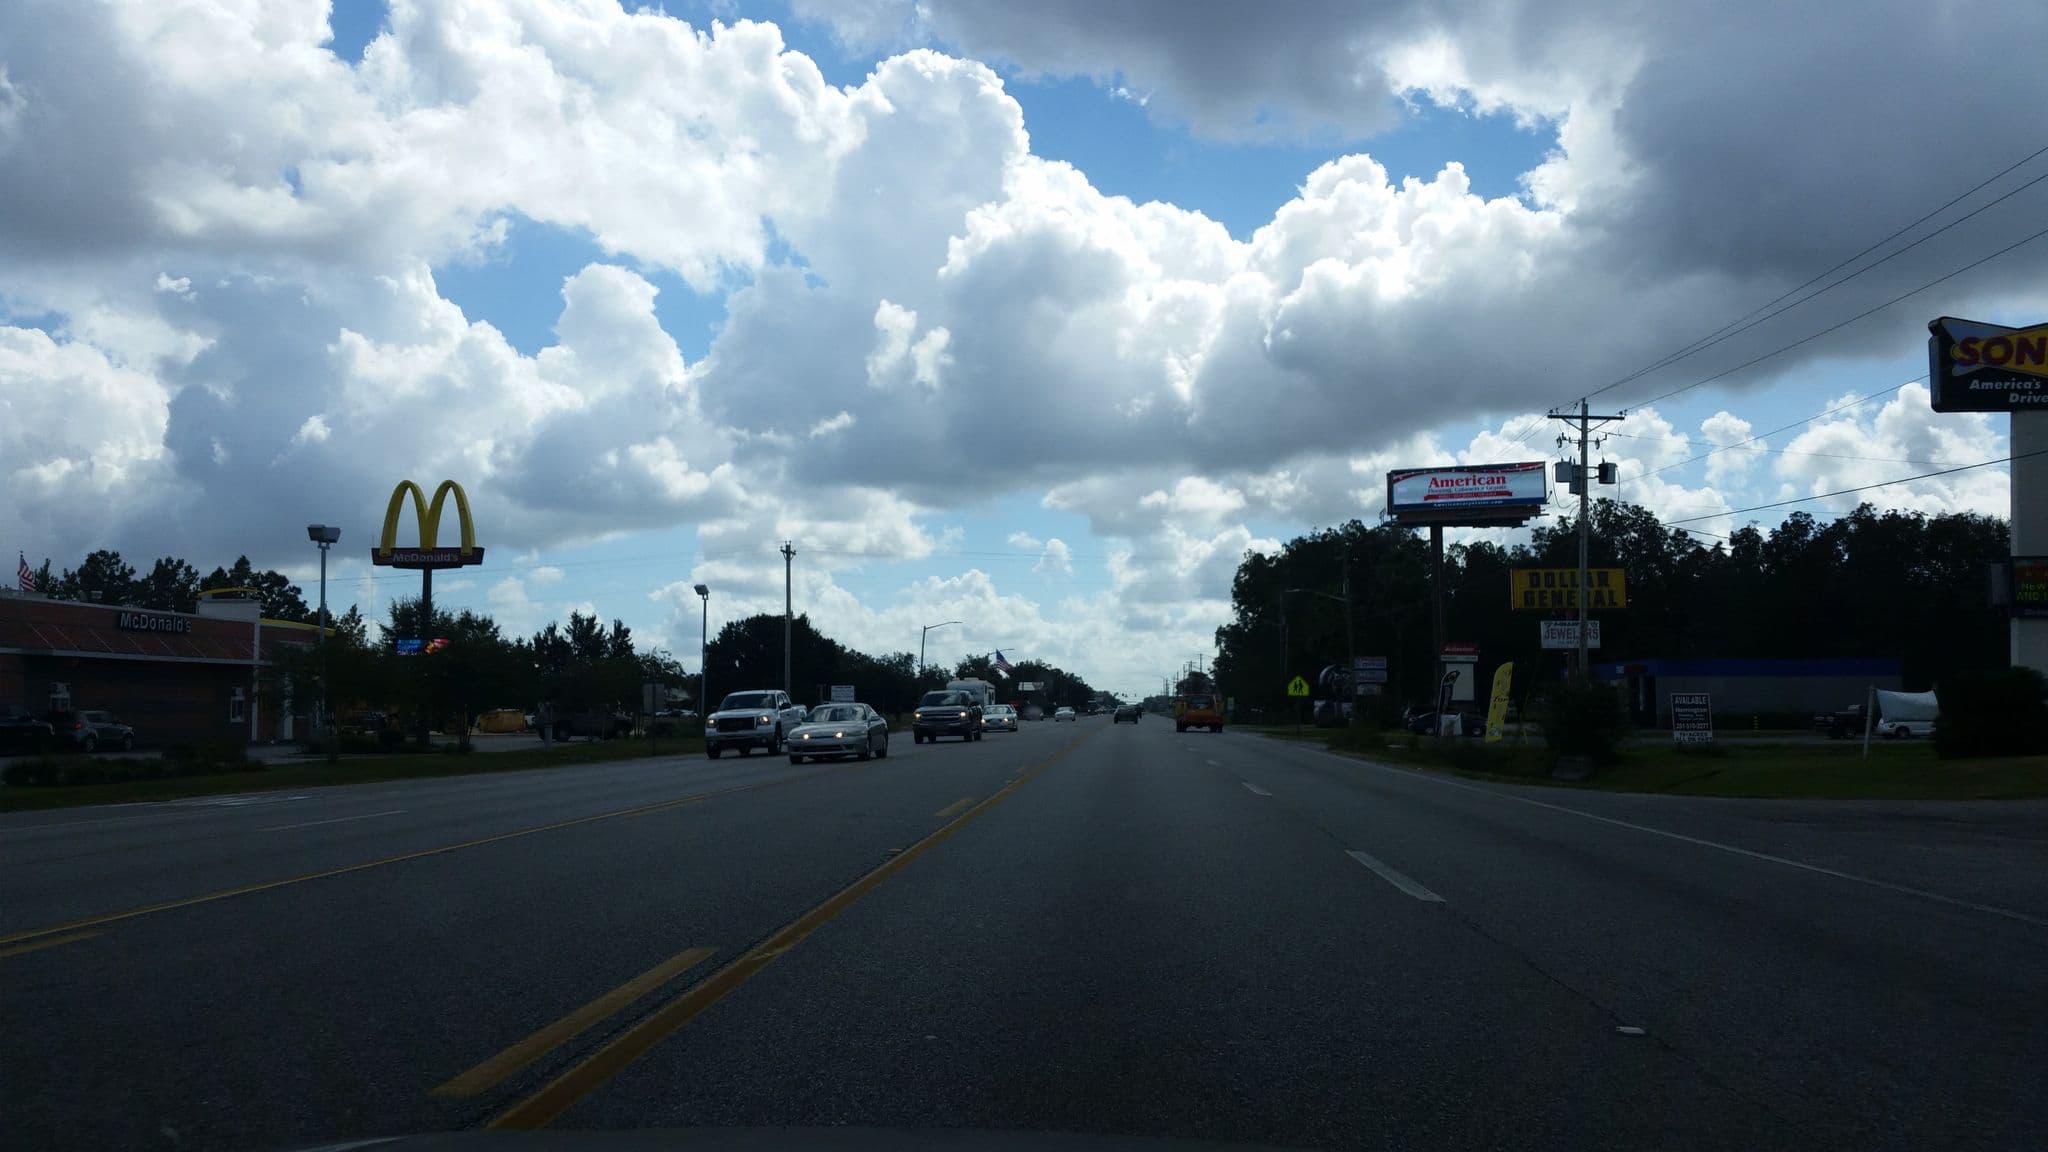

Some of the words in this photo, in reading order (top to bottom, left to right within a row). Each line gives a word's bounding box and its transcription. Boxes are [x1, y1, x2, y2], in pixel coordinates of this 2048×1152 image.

[1968, 377, 2042, 391] America's
[1428, 475, 1507, 489] American
[393, 552, 459, 562] McDonald's
[120, 612, 192, 633] McDonald's
[1544, 628, 1599, 640] JEWELRS
[1674, 695, 1708, 705] AVAILABLE
